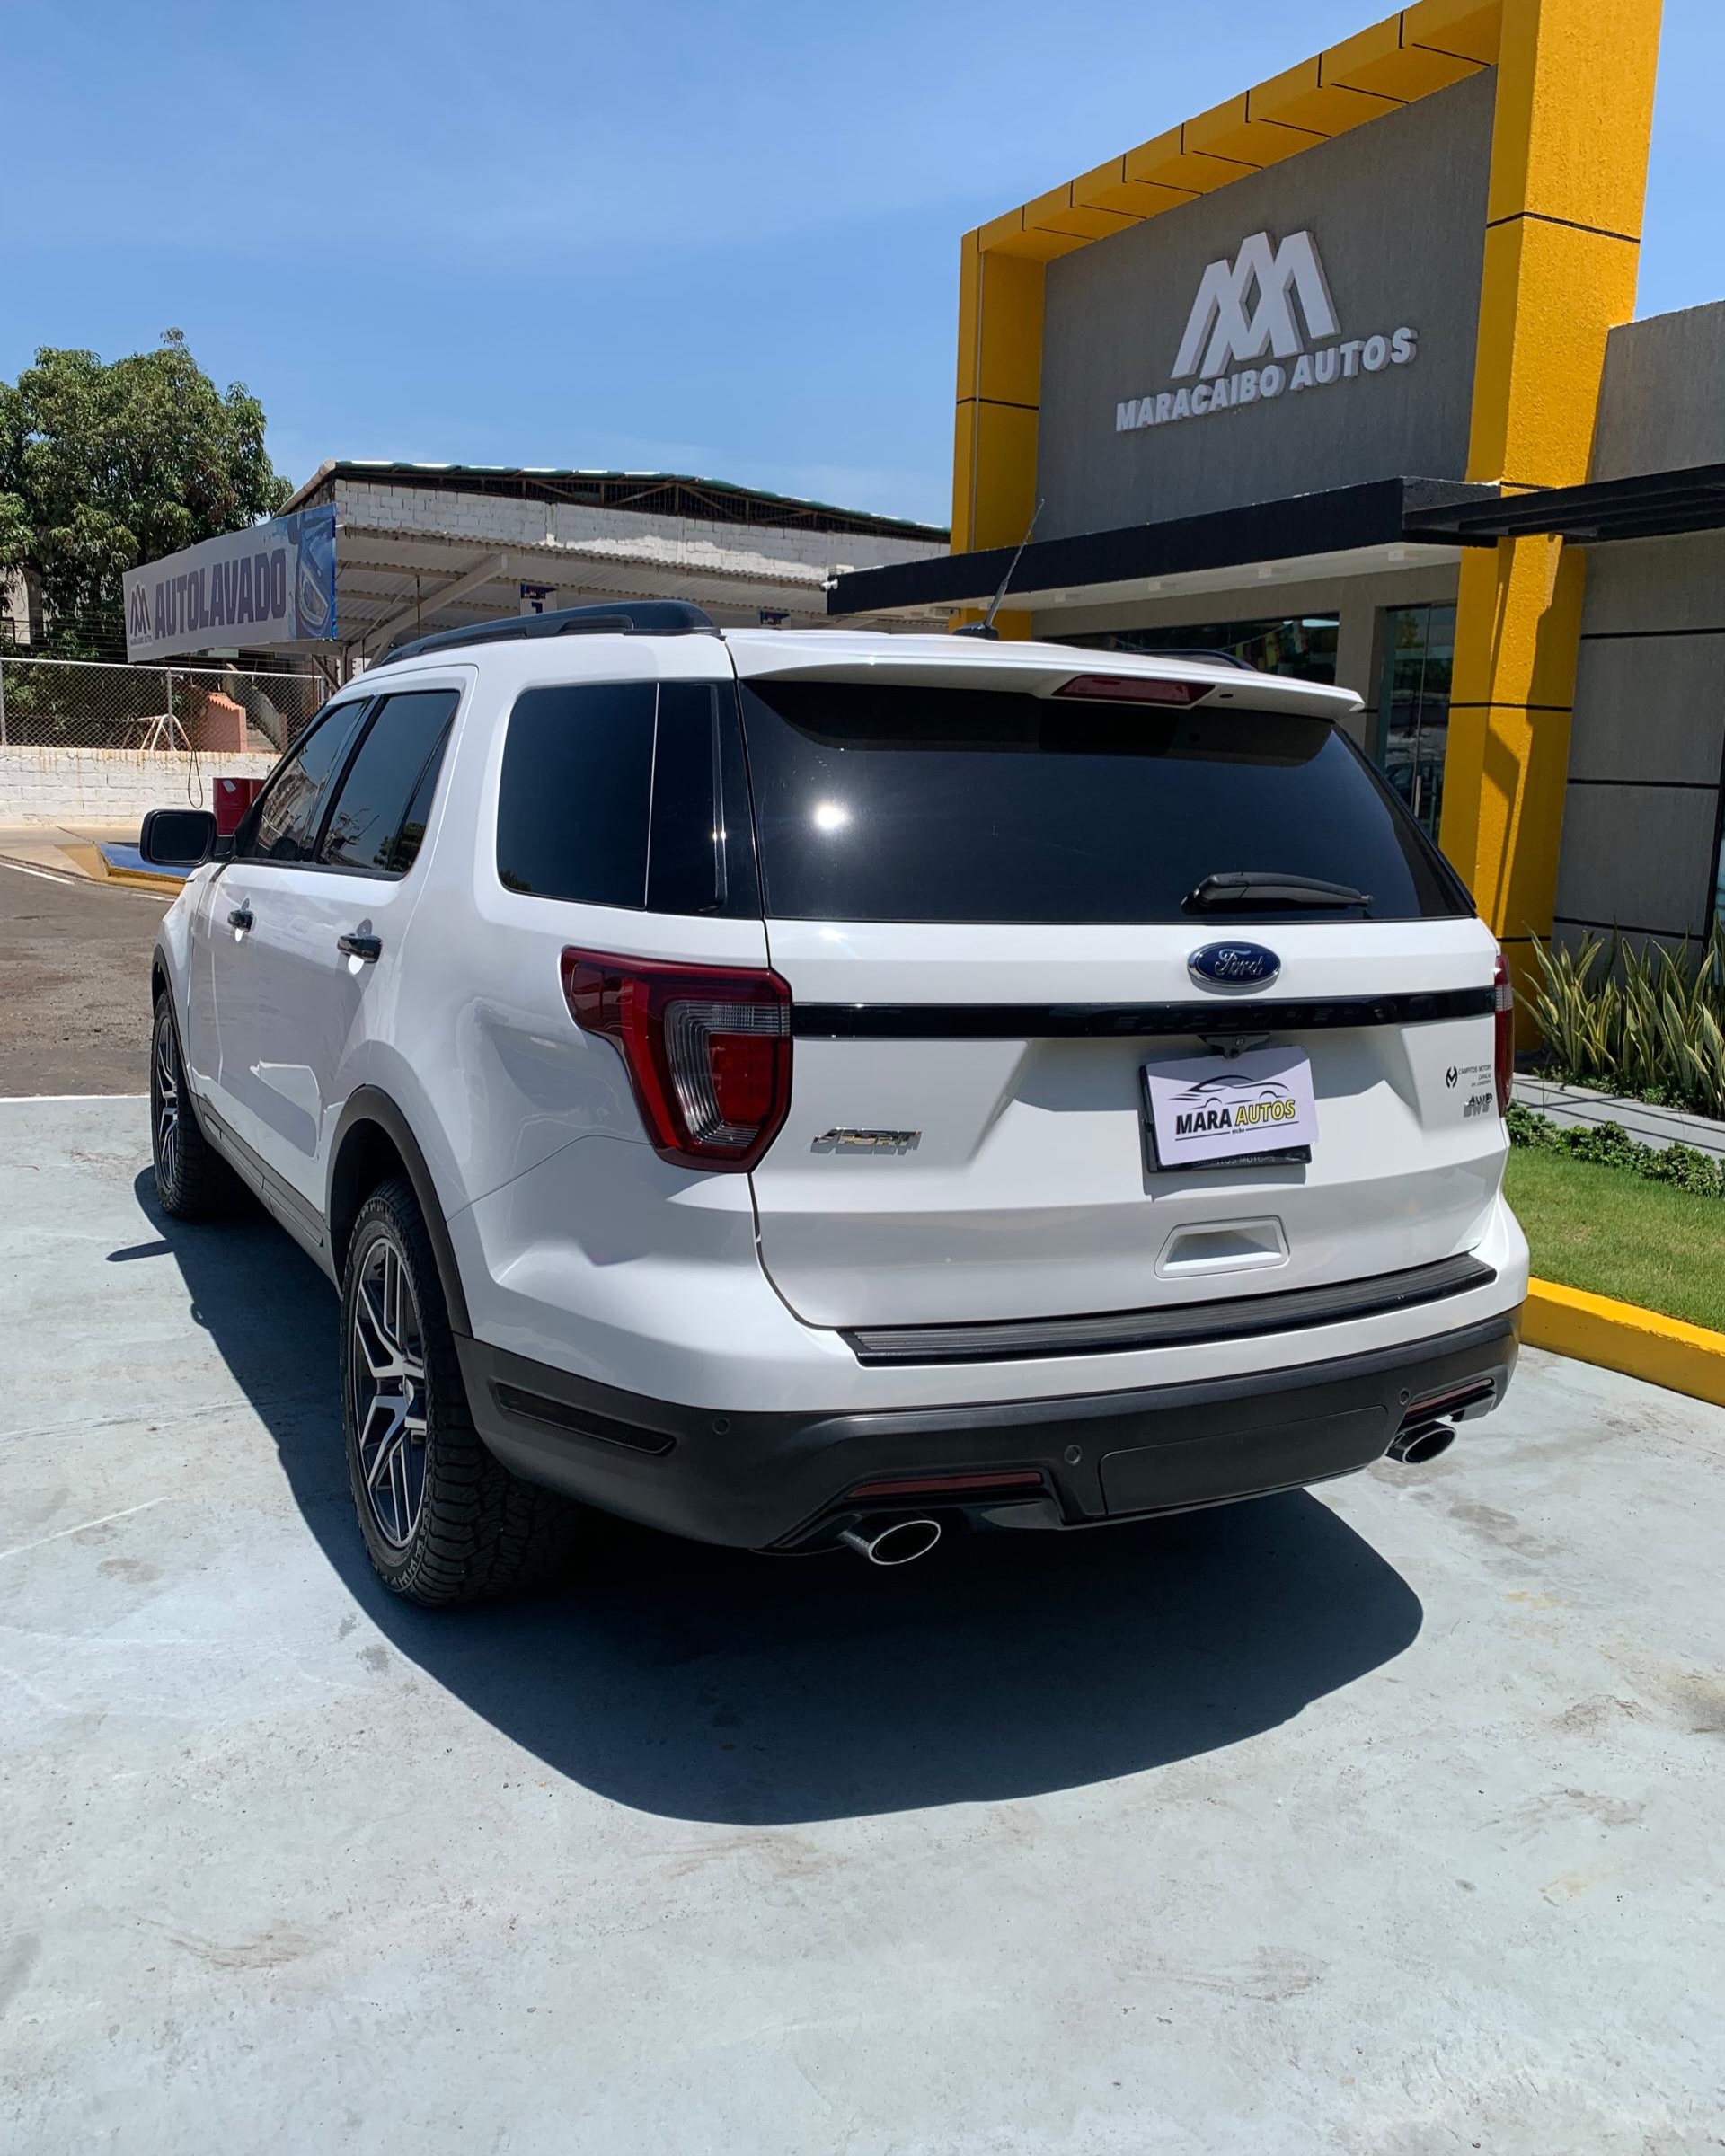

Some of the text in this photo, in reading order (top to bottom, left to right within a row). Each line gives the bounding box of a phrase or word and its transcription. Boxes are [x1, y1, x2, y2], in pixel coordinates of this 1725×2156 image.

[1116, 327, 1418, 431] MARACAIBO AUTOS
[155, 548, 287, 640] AUTOLAVADO
[1214, 949, 1263, 976] Ford
[1175, 1100, 1296, 1135] MARA AUTOS
[812, 1127, 921, 1150] SPORT
